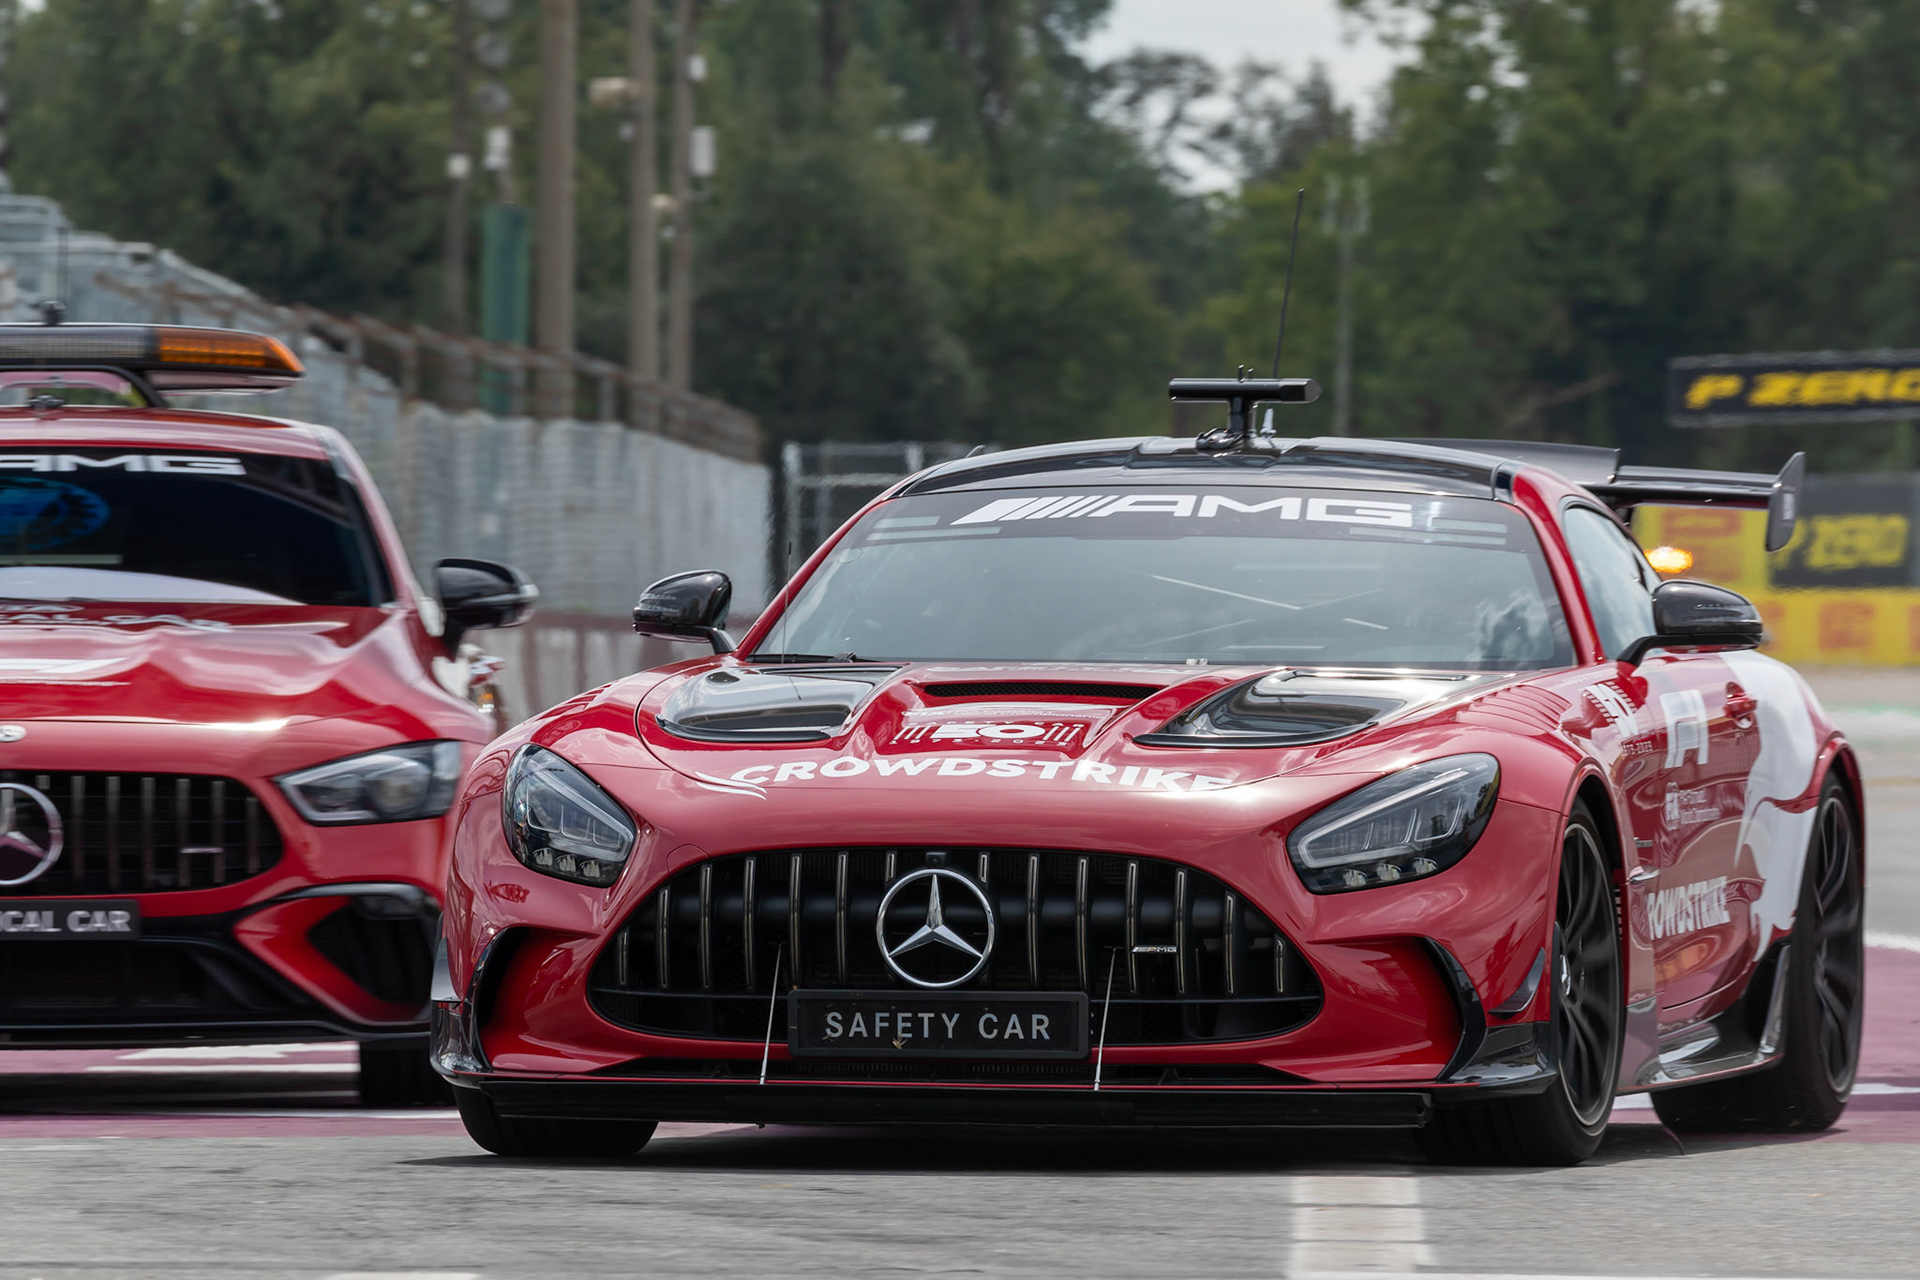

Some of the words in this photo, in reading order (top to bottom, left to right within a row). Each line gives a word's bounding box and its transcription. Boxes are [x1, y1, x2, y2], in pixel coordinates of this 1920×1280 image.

[1088, 494, 1412, 527] AMG
[929, 723, 1046, 739] 50
[730, 756, 1234, 792] CROWDSTRIKE
[67, 911, 131, 932] CAR
[825, 1011, 960, 1039] SAFETY
[978, 1013, 1050, 1040] CAR
